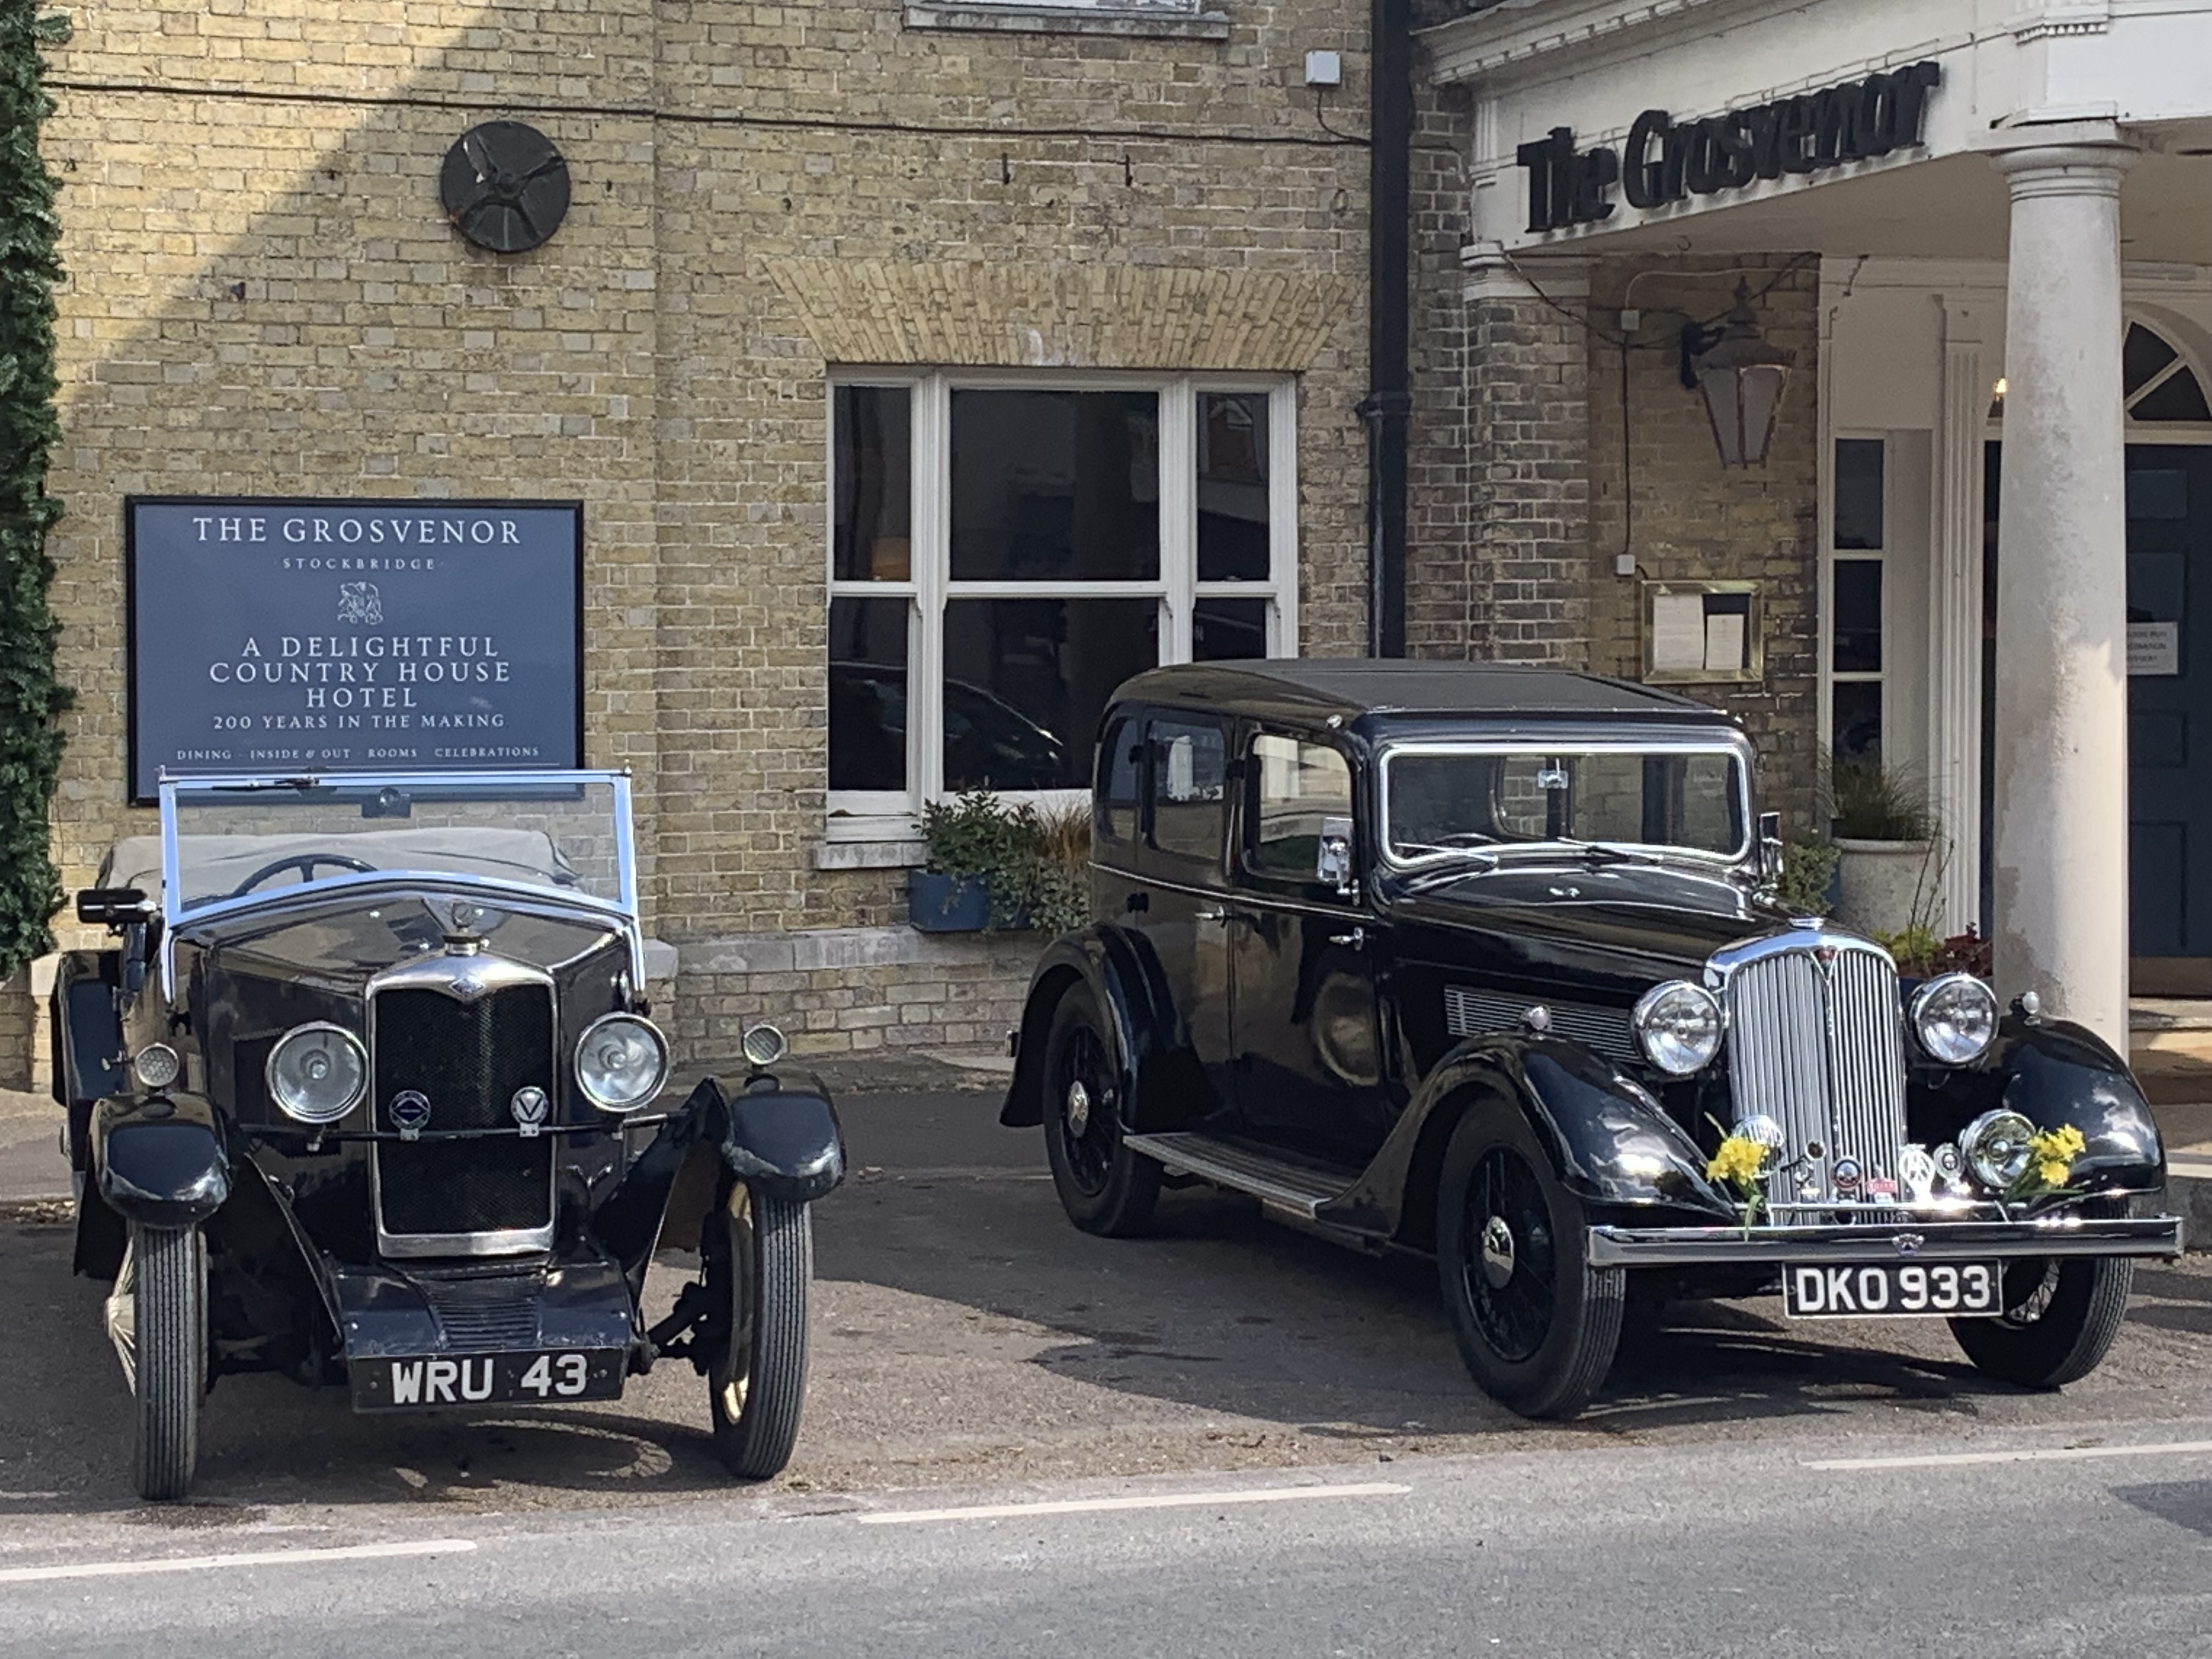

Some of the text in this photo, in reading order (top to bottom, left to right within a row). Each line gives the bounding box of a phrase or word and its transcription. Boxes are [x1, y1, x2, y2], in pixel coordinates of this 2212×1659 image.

[1517, 60, 1940, 234] The Grosvenor
[193, 517, 521, 544] THE GROSVENOR
[283, 558, 435, 570] STOCKBRIDGE
[242, 637, 498, 657] A DELIGHTFUL
[210, 662, 510, 682] COUNTRY HOUSE
[307, 687, 417, 708] HOTEL
[213, 714, 505, 729] 200 YEARS IN THE MAKING
[177, 747, 539, 760] DINING INSIDE & OUT ROOMS CELEBRATIONS
[1796, 1265, 1990, 1312] DKO 933
[392, 1355, 588, 1404] WRU 43
